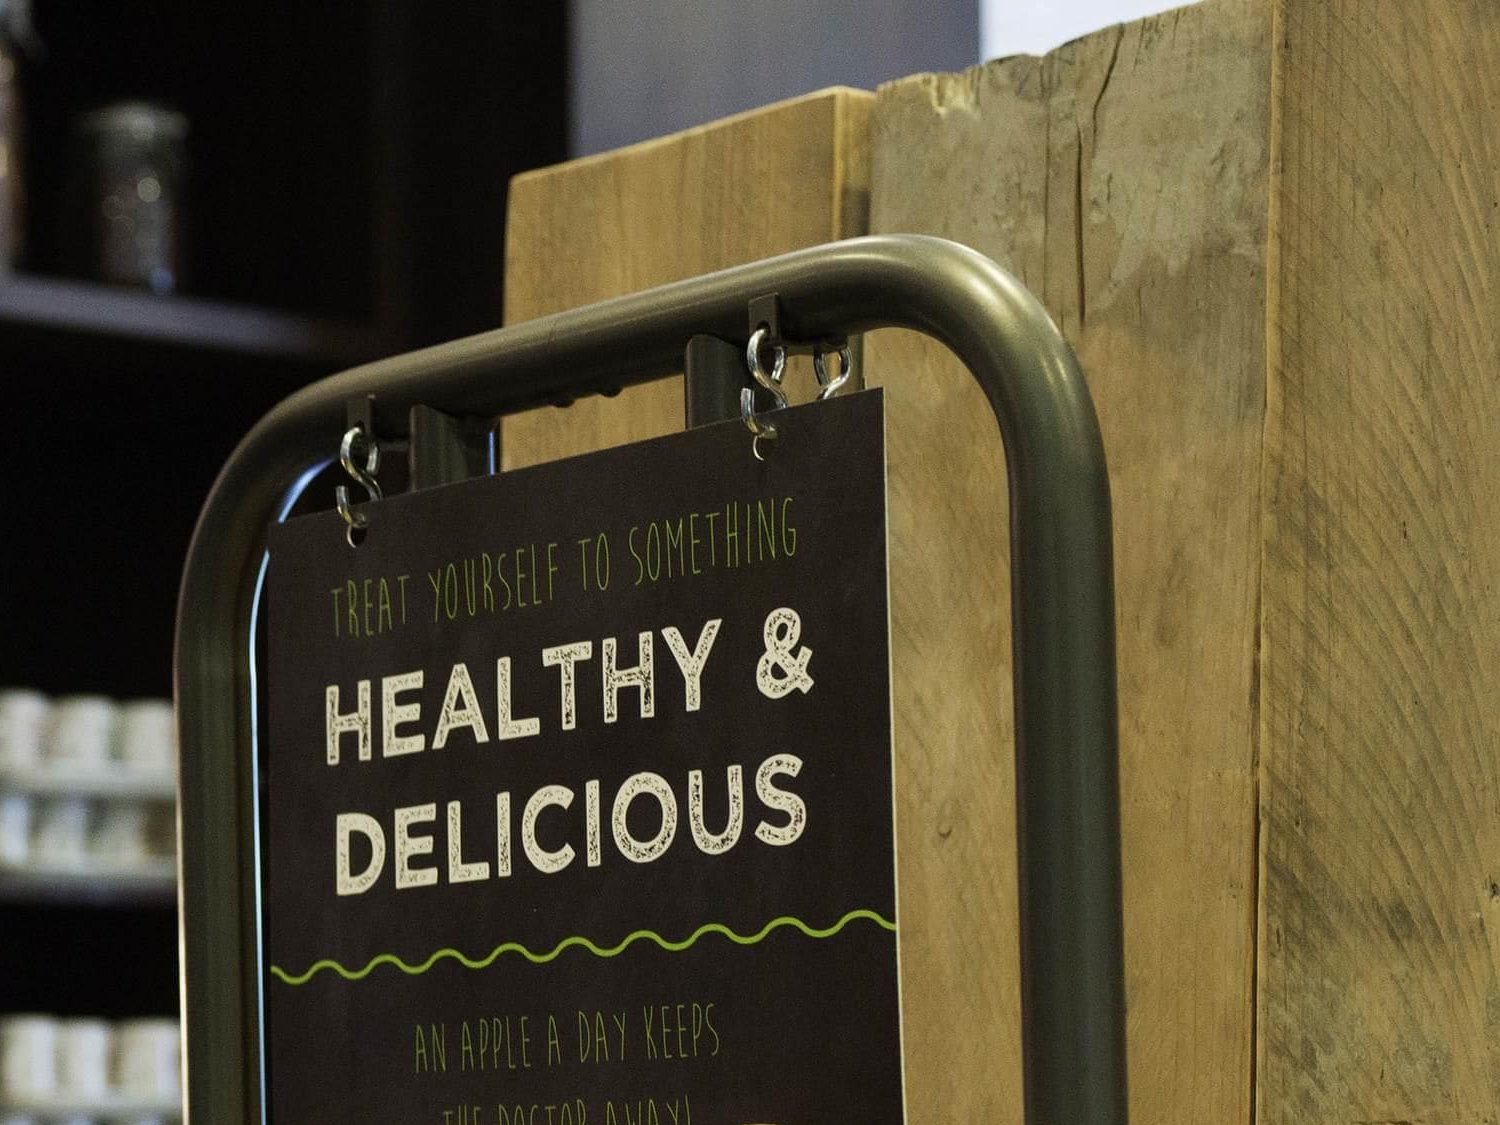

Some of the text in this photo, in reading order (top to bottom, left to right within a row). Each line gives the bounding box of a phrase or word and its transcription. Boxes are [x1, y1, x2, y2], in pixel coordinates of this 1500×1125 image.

[331, 496, 797, 638] TREAT YOURSELF TO SOMETHING
[325, 607, 815, 766] HEALTHY &
[335, 753, 807, 896] DELICIOUS
[415, 1002, 720, 1074] AN APPLE A DAY KEEPS
